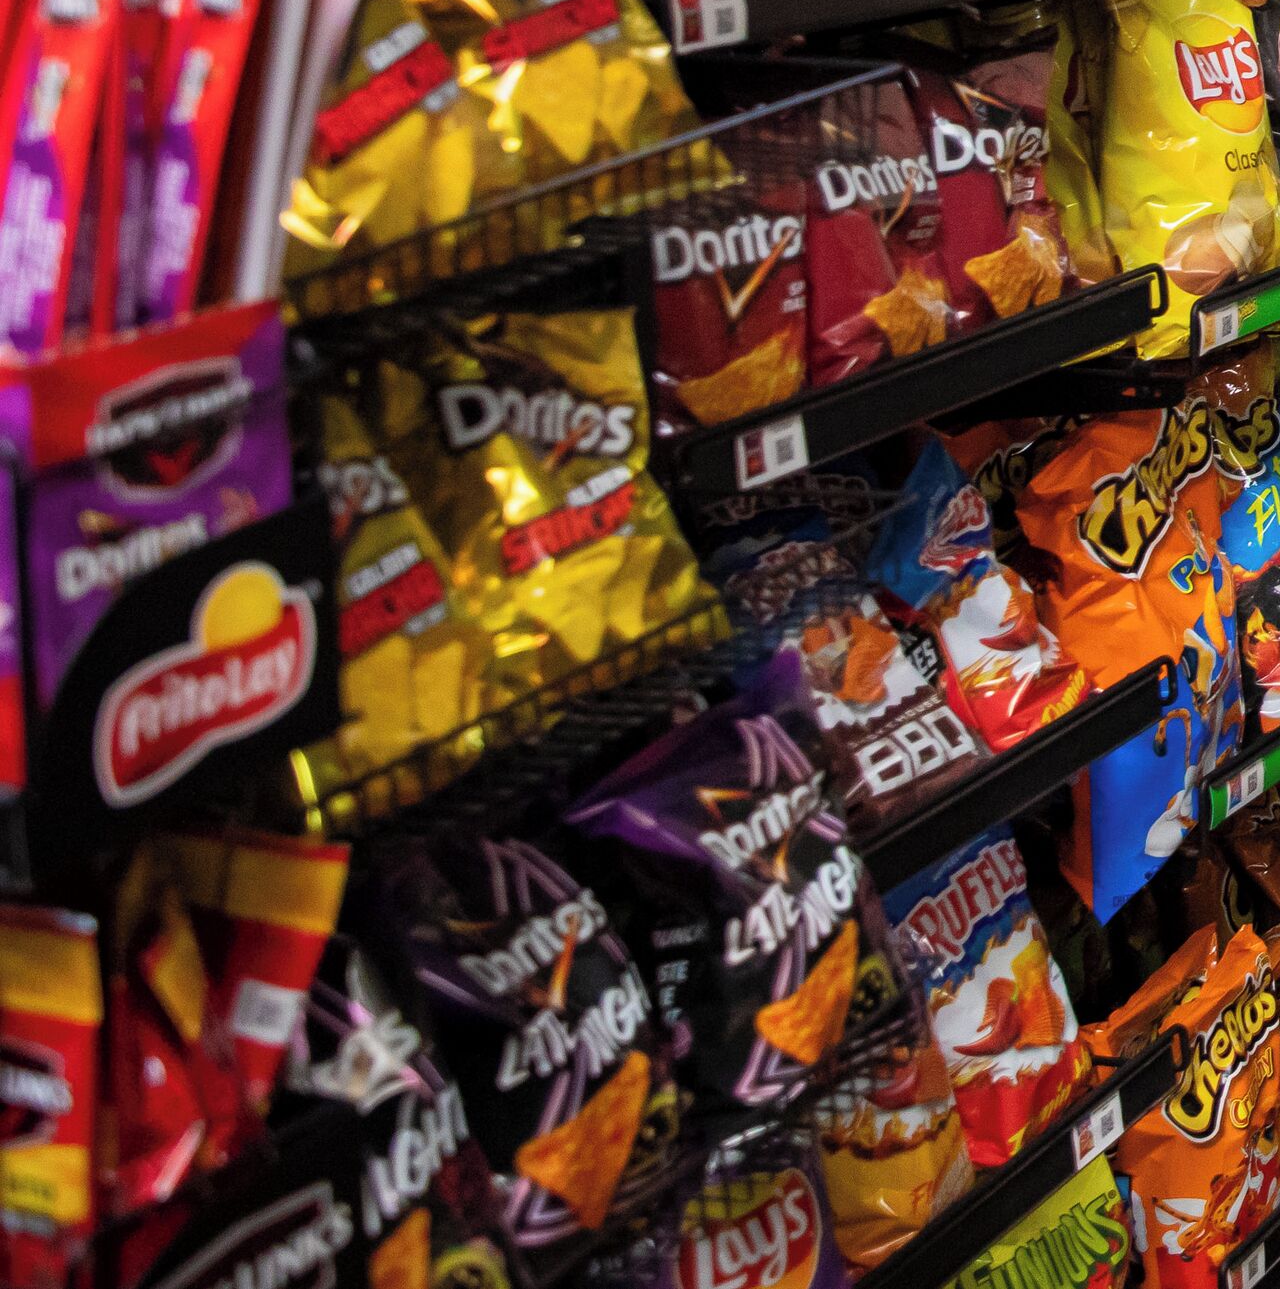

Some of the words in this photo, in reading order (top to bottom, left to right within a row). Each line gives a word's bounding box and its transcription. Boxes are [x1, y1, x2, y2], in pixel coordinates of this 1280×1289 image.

[1185, 35, 1258, 104] Lay's
[653, 215, 803, 283] Dorito
[441, 384, 634, 454] Doritos
[855, 705, 977, 797] BBQ
